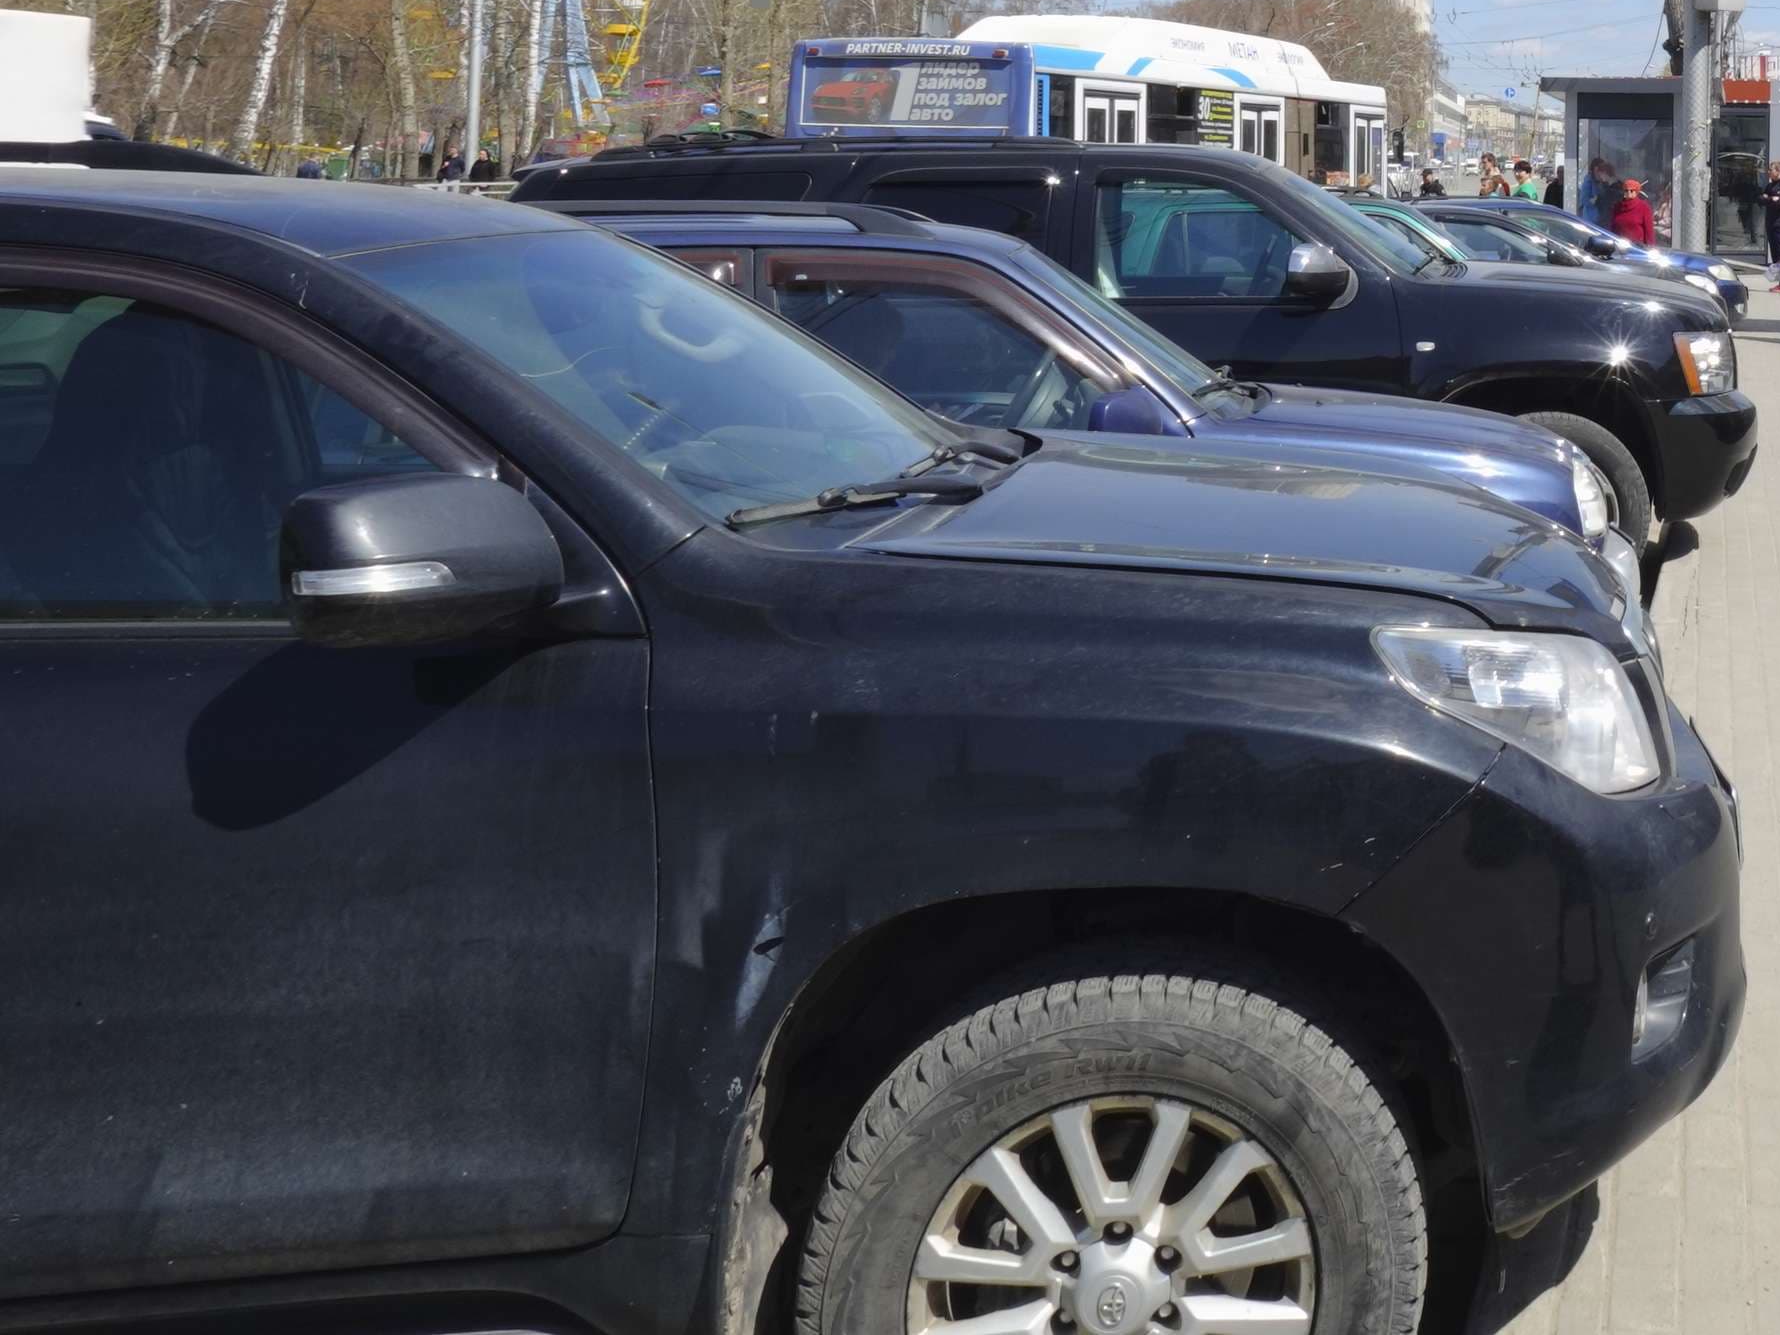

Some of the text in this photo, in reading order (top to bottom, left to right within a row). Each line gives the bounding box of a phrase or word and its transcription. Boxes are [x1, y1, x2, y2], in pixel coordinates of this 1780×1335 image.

[846, 43, 970, 56] PARTNER-INVEST.RU
[921, 63, 980, 77] лидер
[917, 75, 987, 90] займов
[913, 92, 1007, 106] под залог
[910, 109, 954, 121] авто
